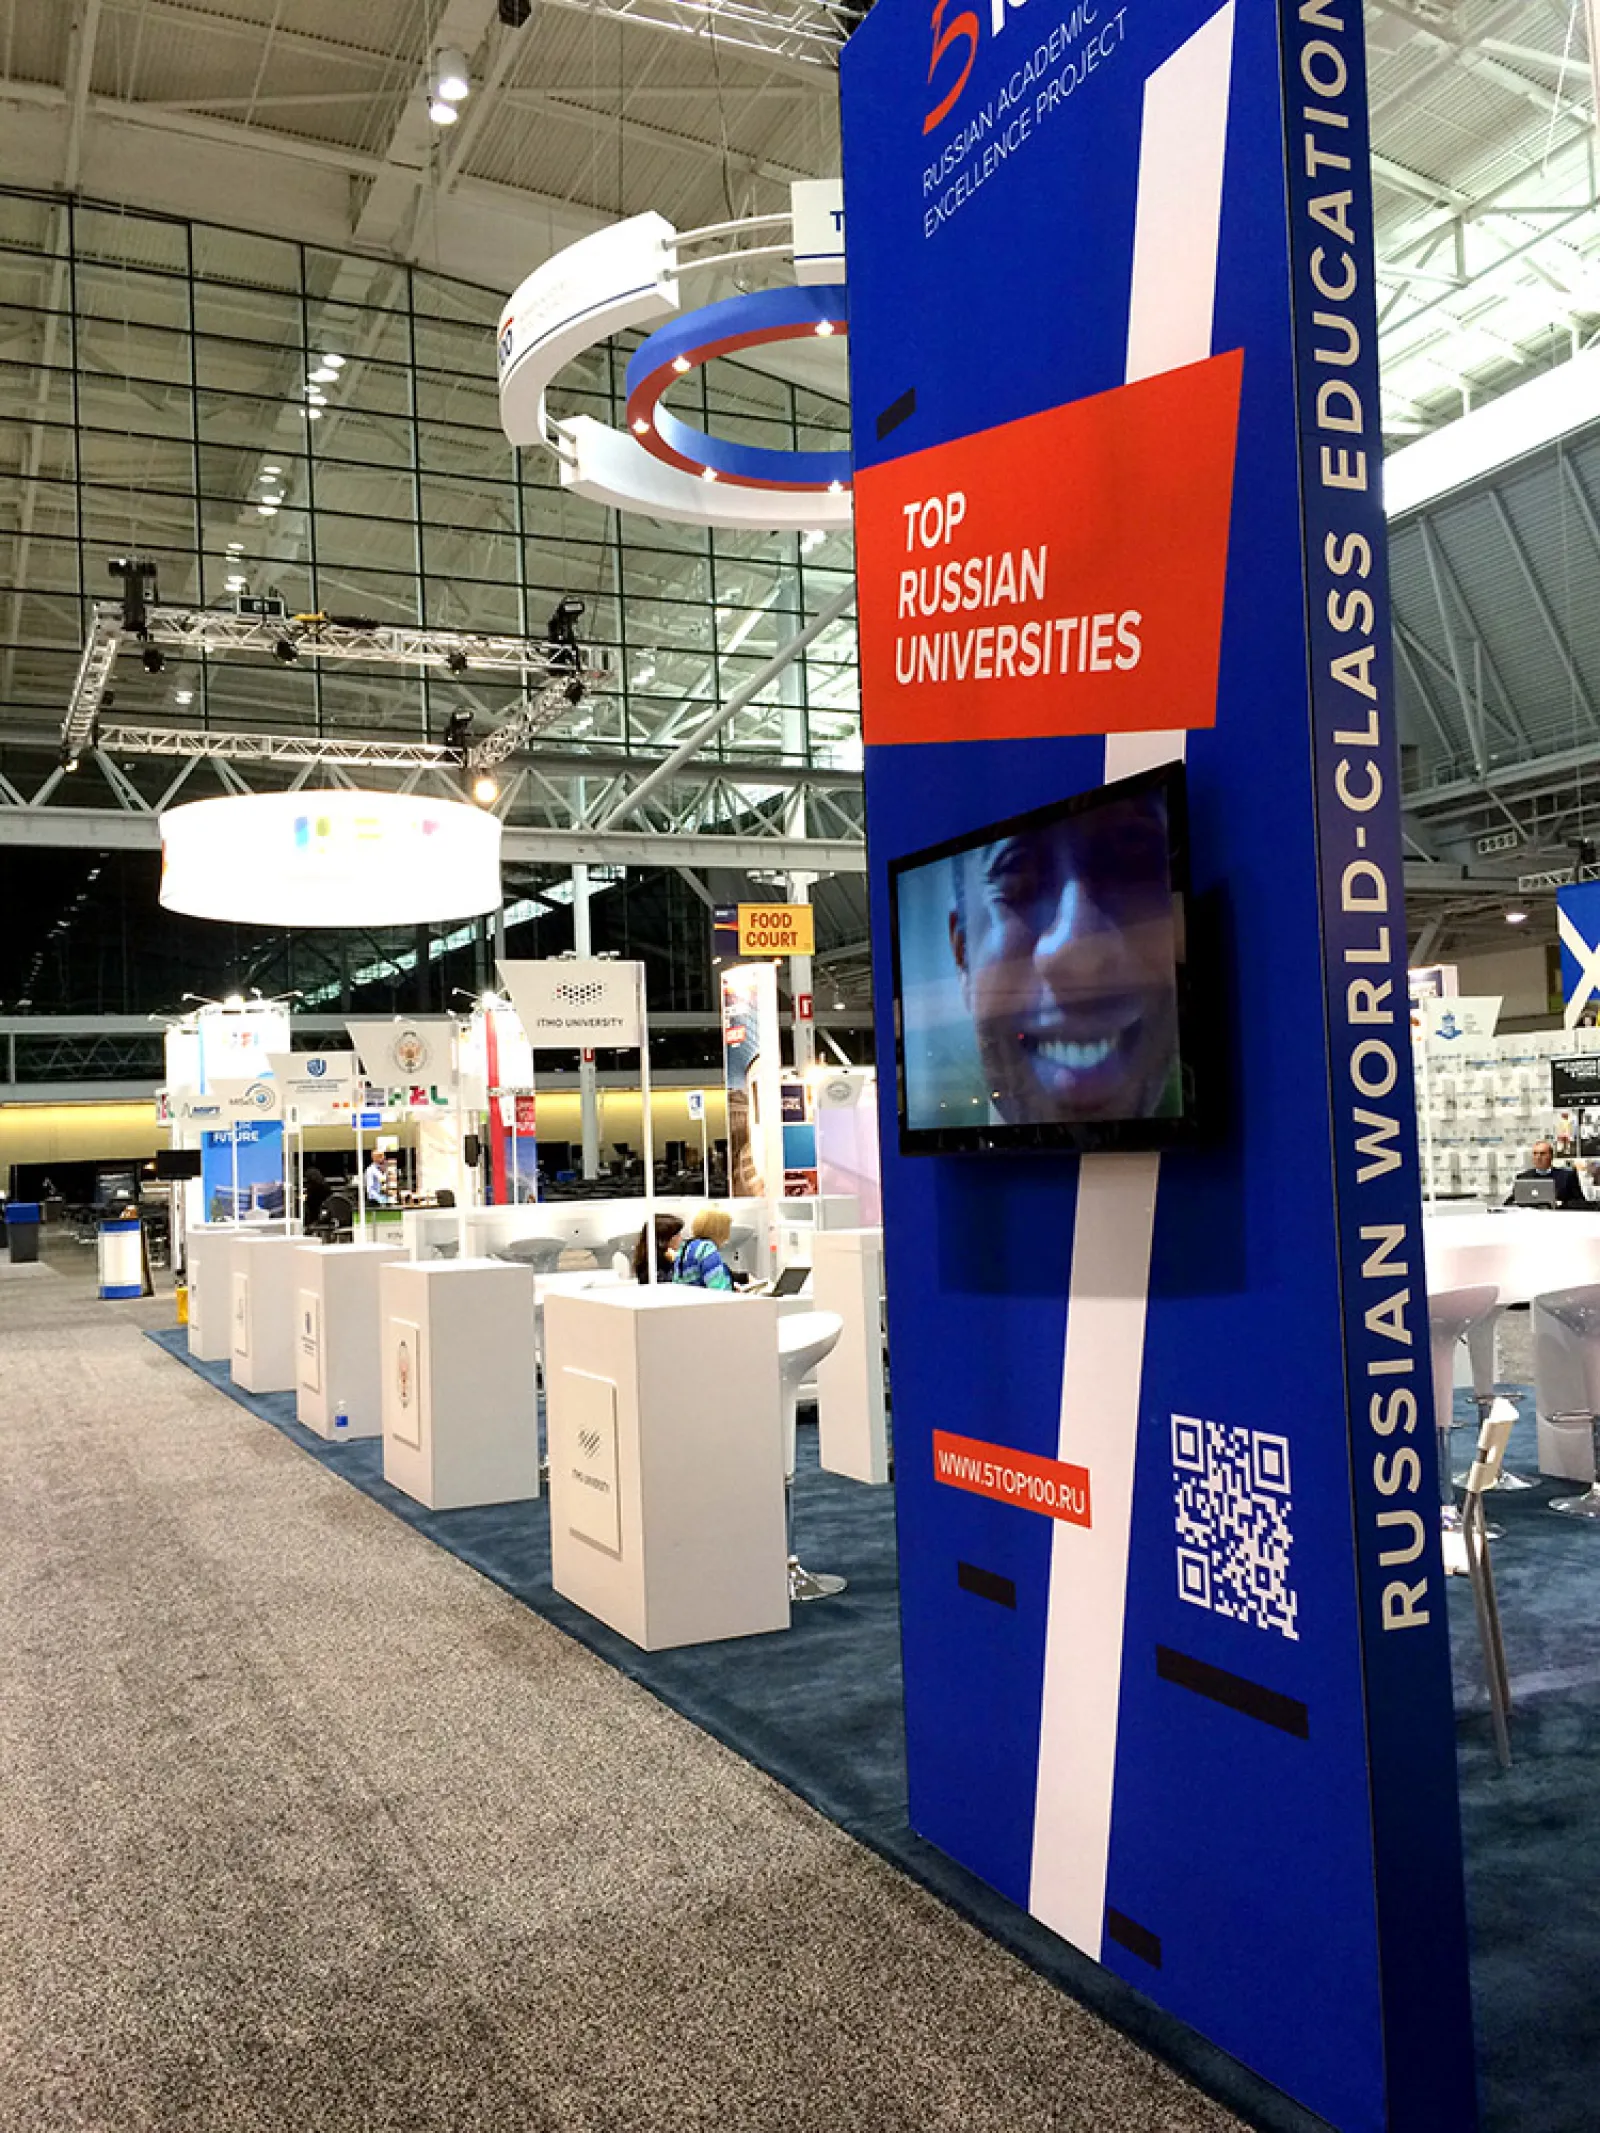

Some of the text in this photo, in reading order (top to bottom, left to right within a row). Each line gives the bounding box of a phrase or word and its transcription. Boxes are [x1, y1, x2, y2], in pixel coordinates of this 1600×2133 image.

[923, 102, 993, 197] RUSSIAN
[996, 0, 1098, 119] ACADEMIC
[924, 6, 1127, 239] EXCELLENCE PROJECT
[903, 491, 967, 552] TOP
[898, 545, 1048, 619] RUSSIAN
[895, 610, 1142, 684] UNIVERSITIES
[1298, 0, 1430, 1631] RUSSIAN WORLD-CLASS EDUCATION
[746, 931, 798, 947] COURT
[750, 913, 792, 928] FOOD
[537, 1015, 623, 1028] ITMO UNIVERSITY
[213, 1130, 258, 1142] FUTURE
[938, 1449, 1085, 1515] WWW.5TOP100.RU
